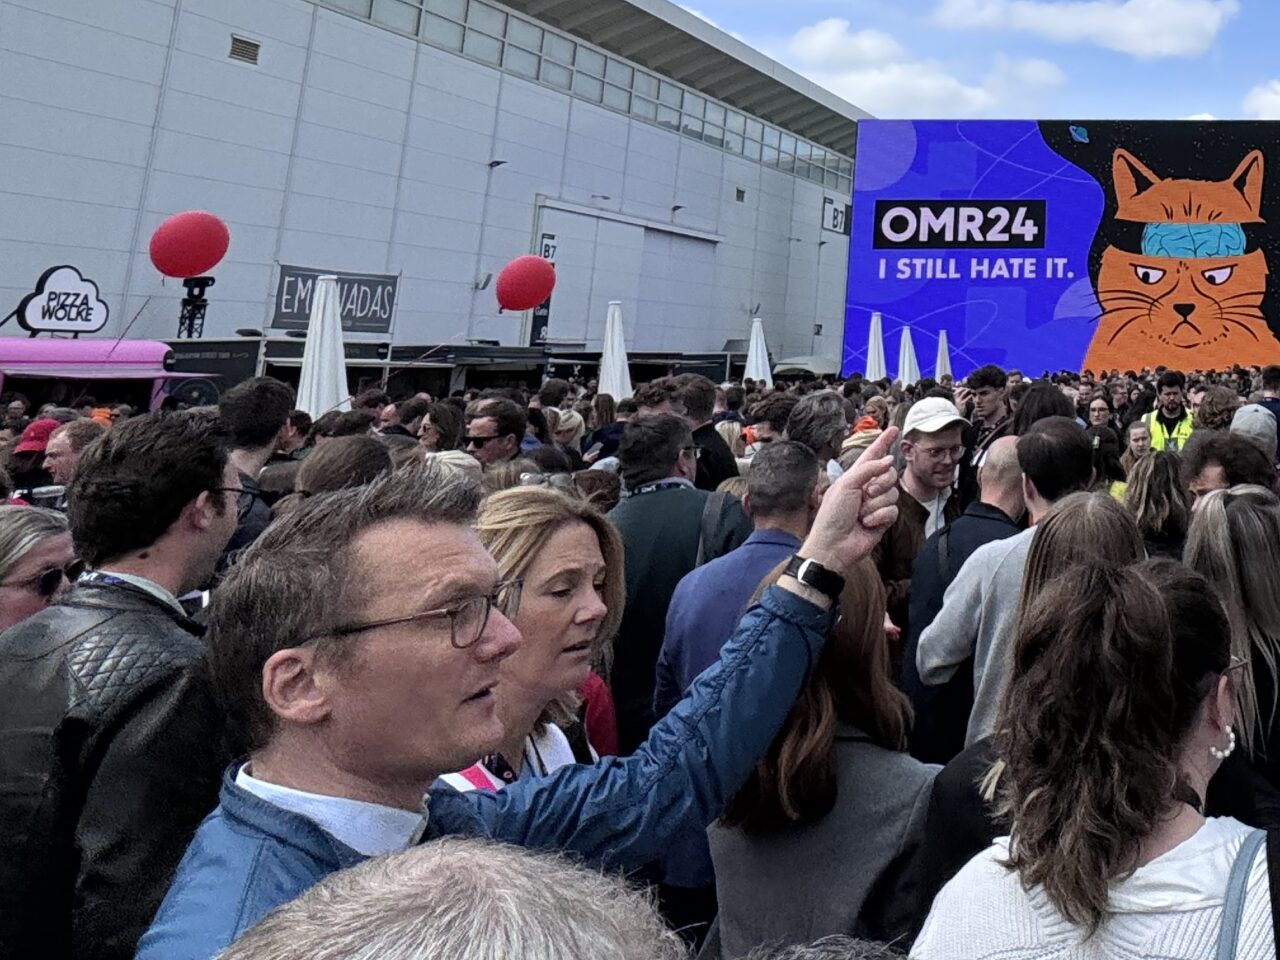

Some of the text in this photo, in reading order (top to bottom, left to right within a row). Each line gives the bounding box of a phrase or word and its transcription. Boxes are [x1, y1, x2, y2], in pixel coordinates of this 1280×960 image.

[832, 208, 844, 229] B7
[881, 206, 1039, 243] OMR24
[543, 243, 557, 259] B7
[879, 258, 1075, 280] I STILL HATE IT.
[47, 291, 89, 308] PIZZA
[281, 276, 393, 319] EMNADAS
[41, 305, 94, 322] WOLKE
